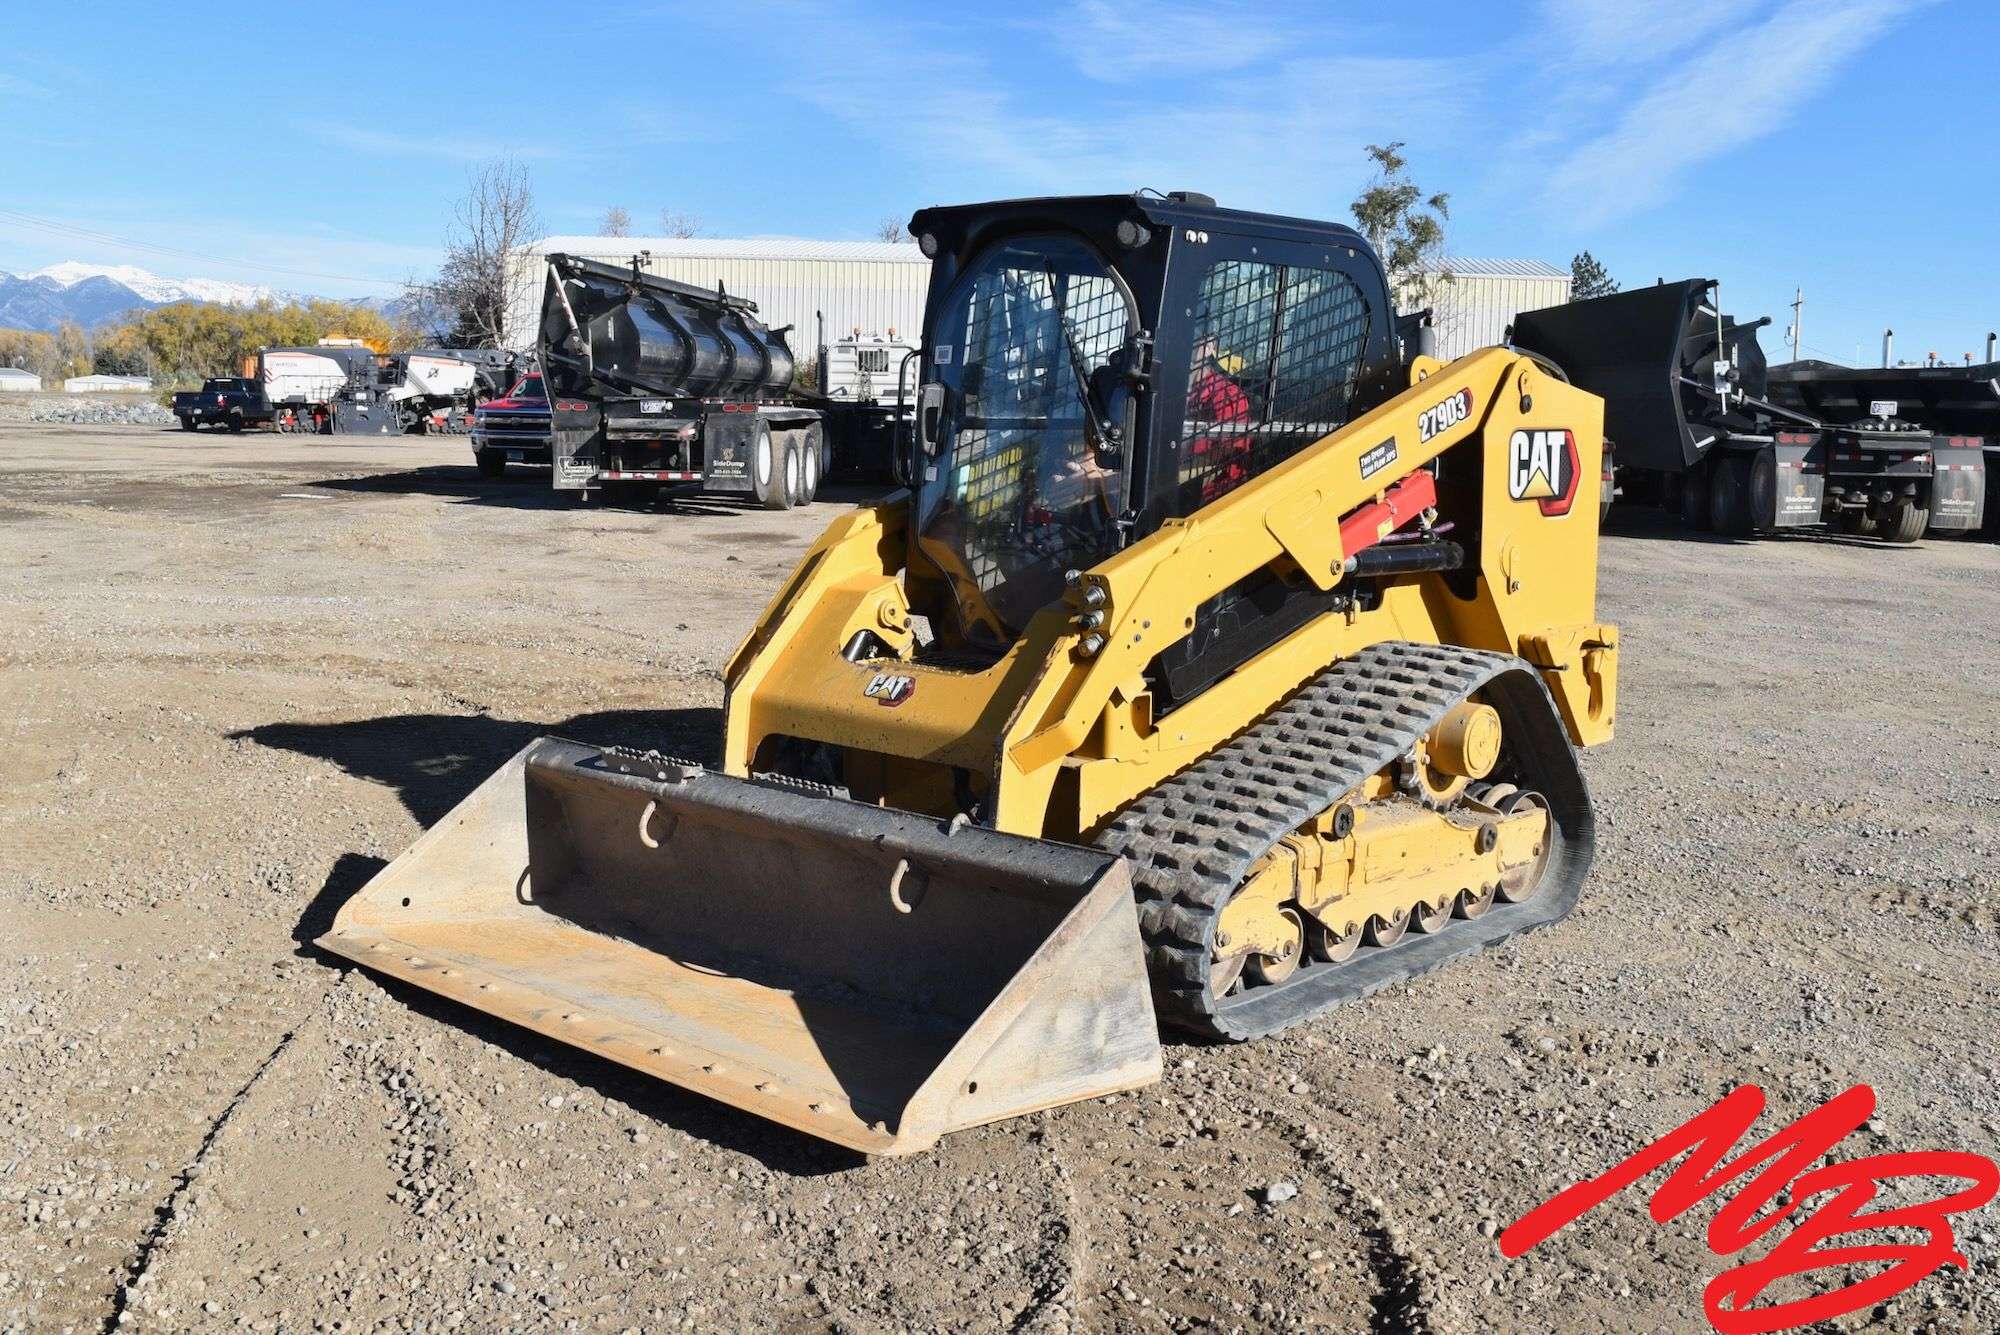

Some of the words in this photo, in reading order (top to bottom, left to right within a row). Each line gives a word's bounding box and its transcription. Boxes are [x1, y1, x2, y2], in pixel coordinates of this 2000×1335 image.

[1418, 391, 1467, 443] 279D3
[712, 460, 745, 468] SideDump
[1510, 431, 1566, 499] CAT
[864, 674, 911, 700] CAT
